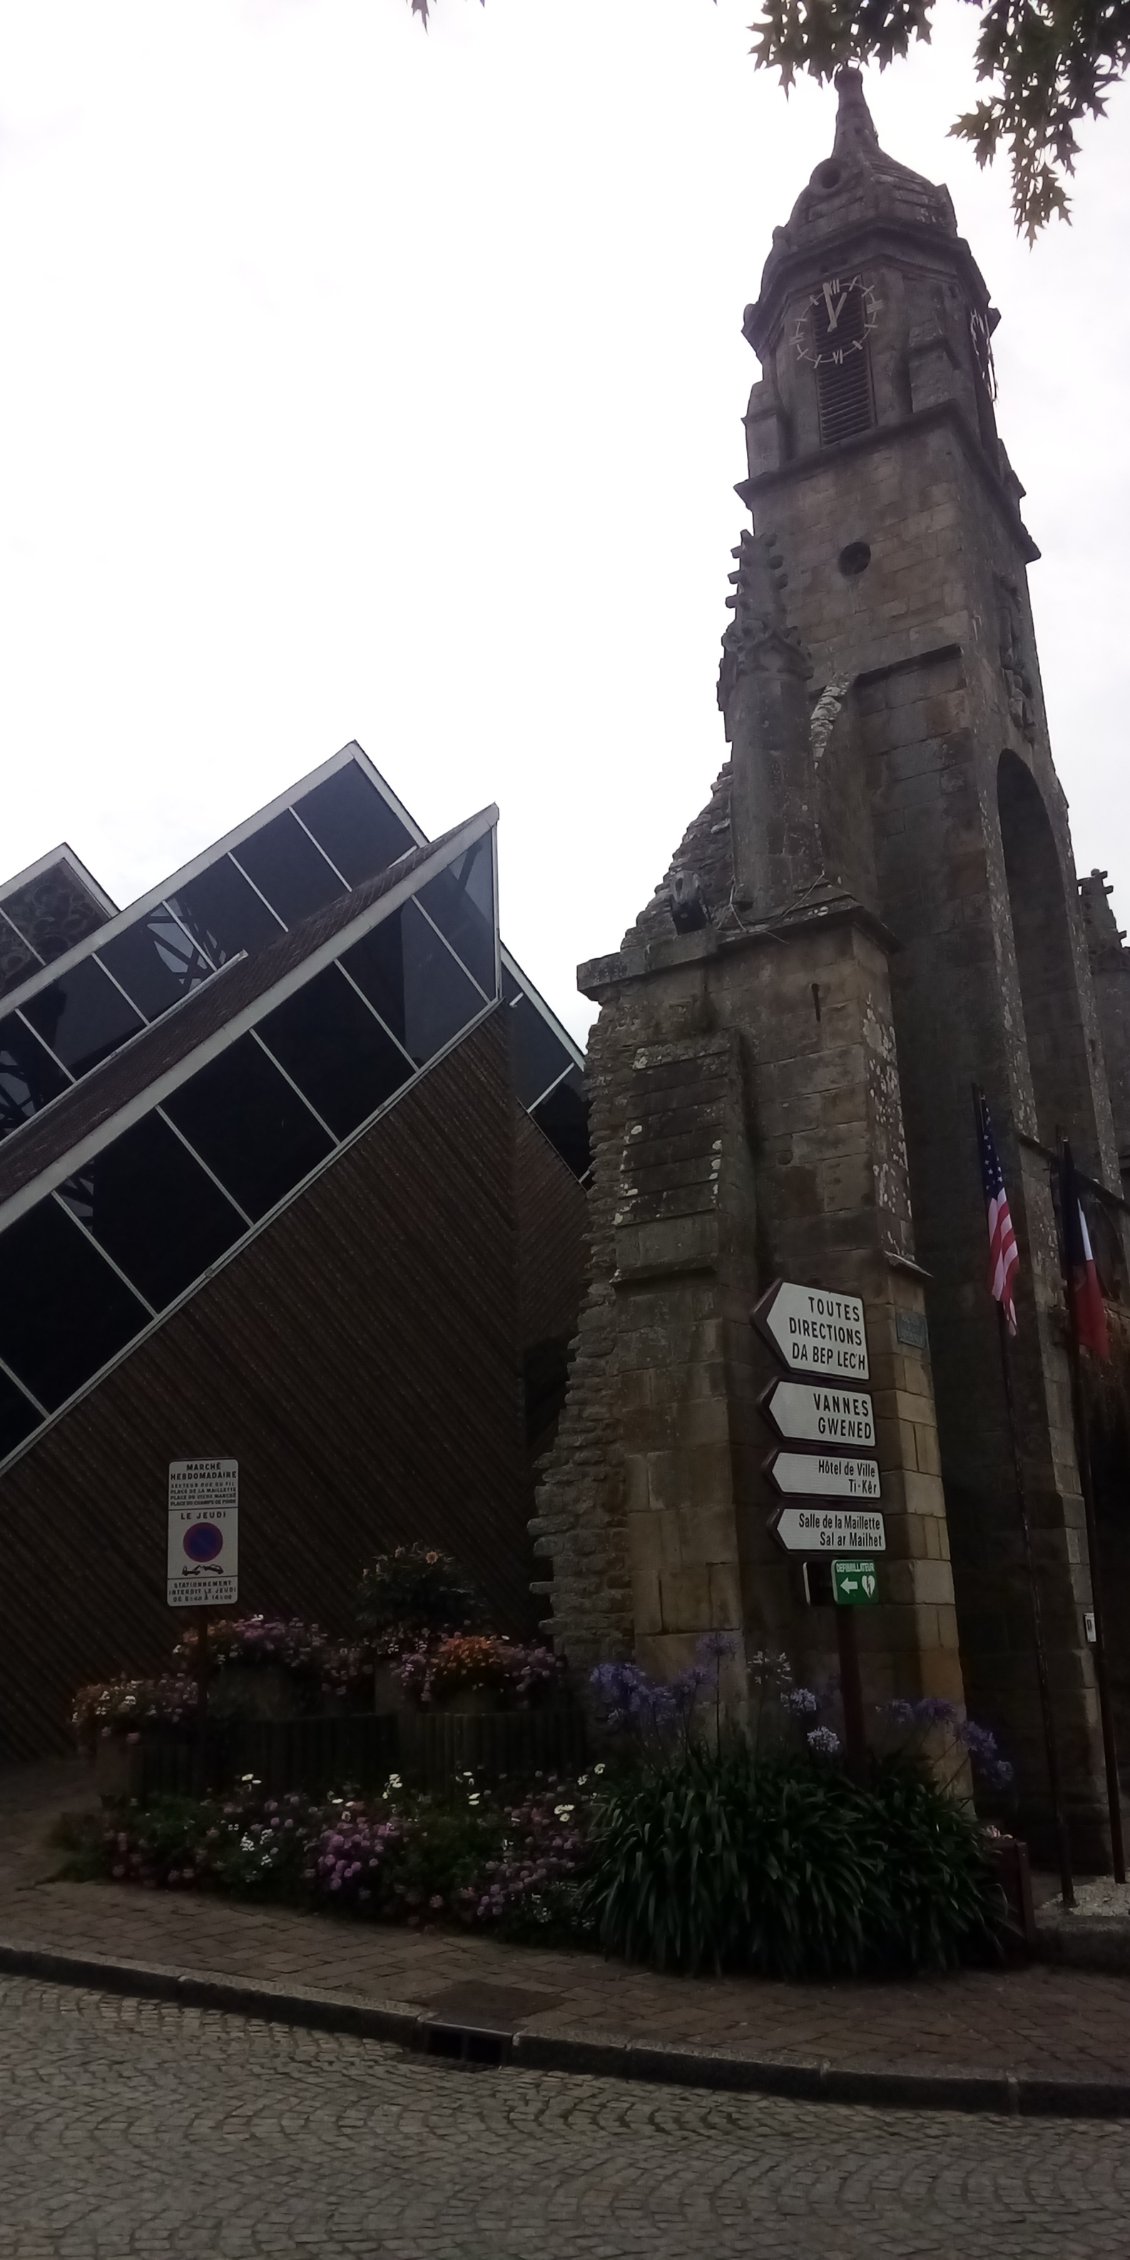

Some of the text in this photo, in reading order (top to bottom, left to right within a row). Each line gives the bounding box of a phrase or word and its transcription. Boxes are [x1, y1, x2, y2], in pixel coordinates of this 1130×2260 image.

[807, 1296, 860, 1322] TOUTES
[788, 1316, 863, 1346] DIRECTIONS
[792, 1342, 808, 1361] DA
[812, 1345, 834, 1365] BEP
[813, 1393, 869, 1417] VANNES
[818, 1416, 871, 1439] GWENED
[170, 1471, 237, 1480] HEBDOMADAIRE
[818, 1459, 876, 1478] Hôtel de Ville
[180, 1511, 226, 1520] LE JEUDI
[798, 1513, 880, 1530] Salle de la Maillette
[819, 1531, 881, 1547] Sal ar Mailhet
[173, 1580, 231, 1588] STATIONNEMENT
